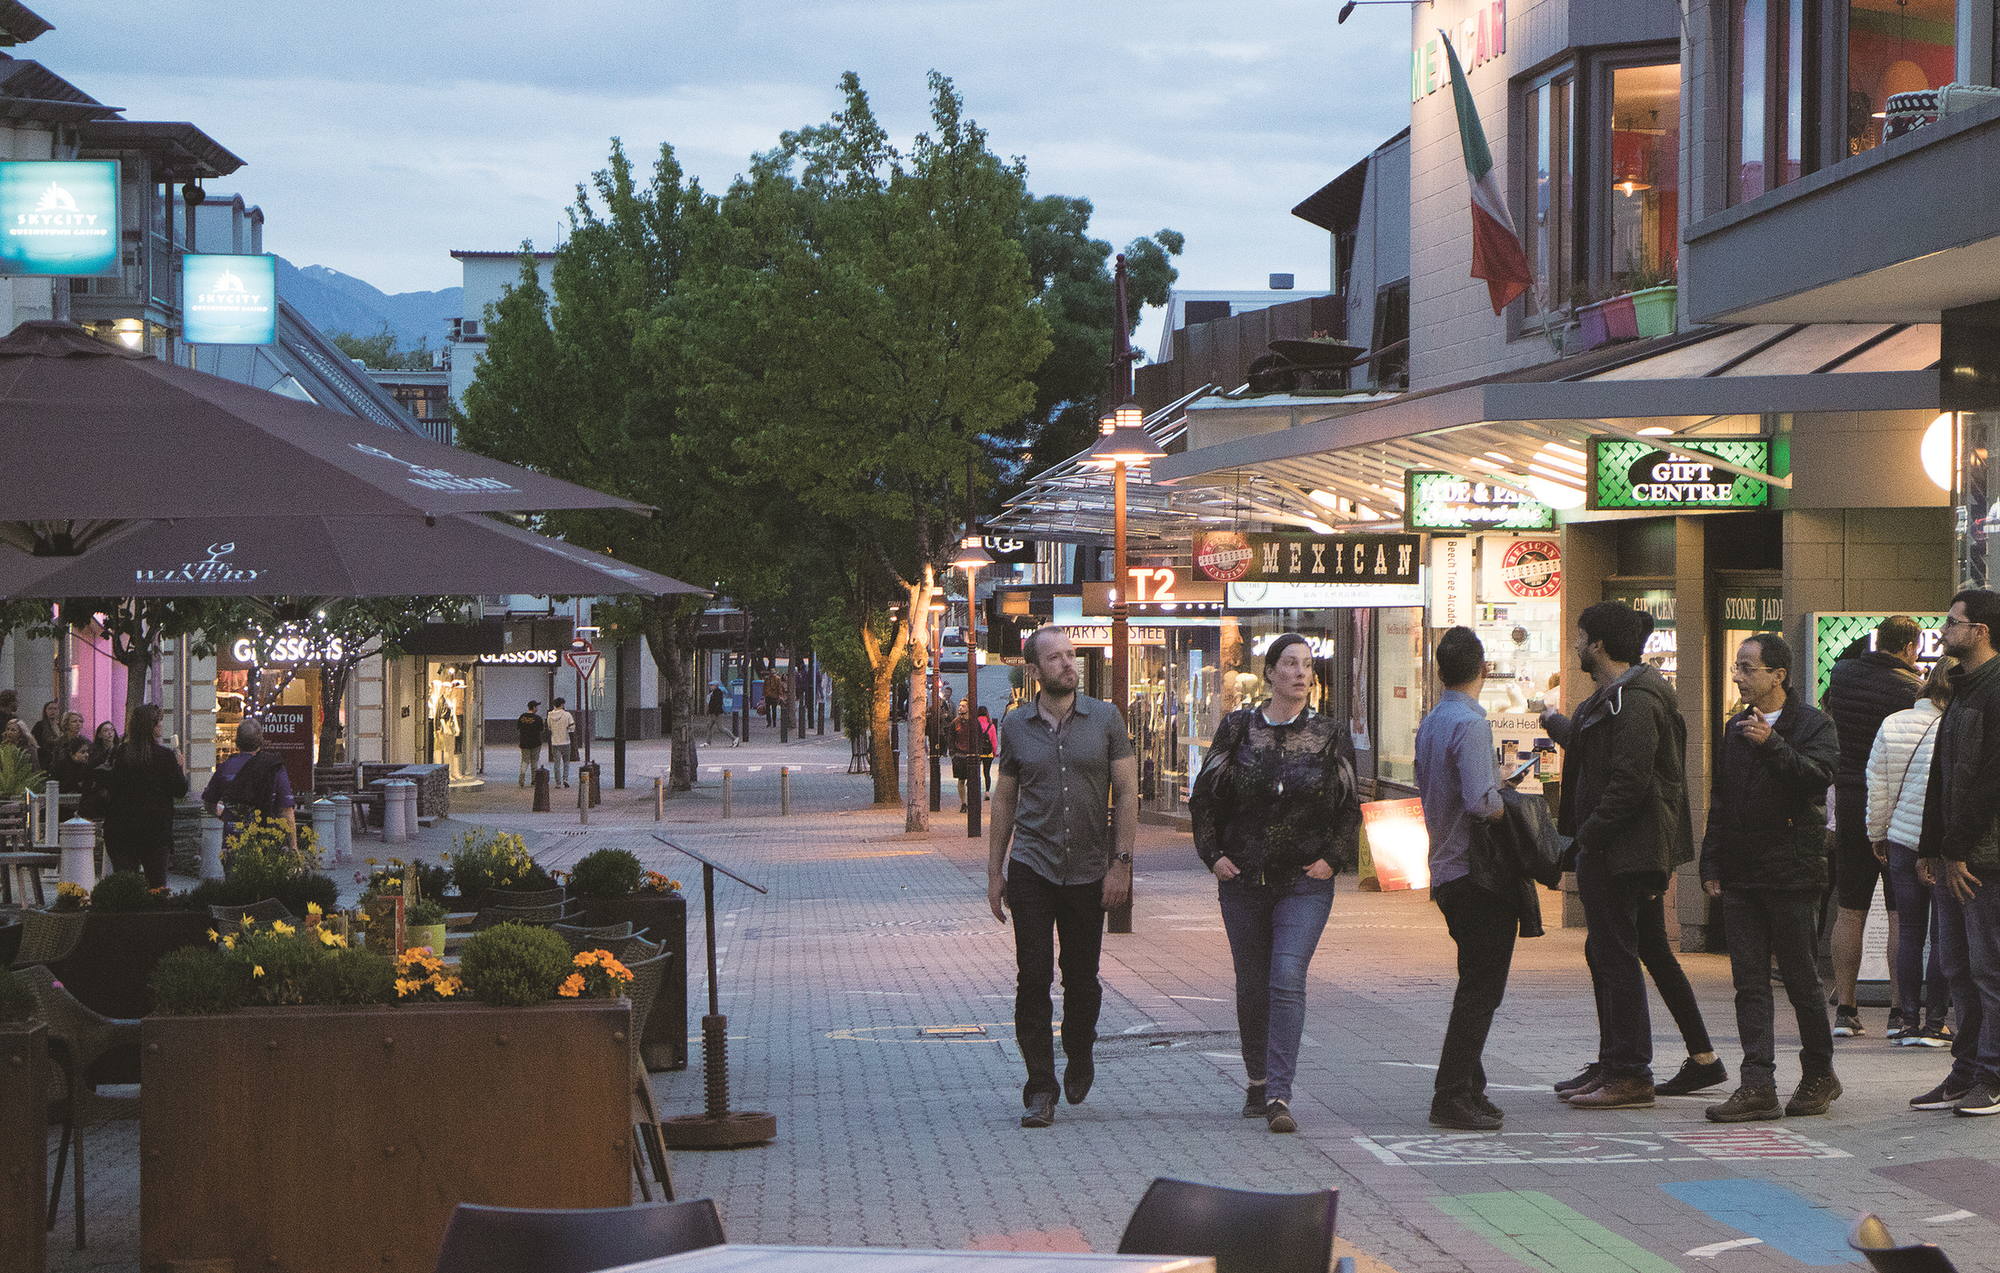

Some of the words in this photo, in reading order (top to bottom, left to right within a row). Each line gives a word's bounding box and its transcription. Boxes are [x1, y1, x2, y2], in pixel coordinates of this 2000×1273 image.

[17, 213, 98, 225] SKYCITY
[198, 293, 261, 304] SKYCITY
[1652, 463, 1713, 482] GIFT
[1632, 483, 1732, 501] CENTRE
[1262, 542, 1413, 576] MEXICAN
[1447, 541, 1458, 568] Beech
[1507, 542, 1558, 563] MEXICAN
[136, 569, 268, 580] WINERY
[182, 562, 233, 571] THE
[1128, 568, 1175, 600] T2
[1447, 572, 1458, 591] Tree
[1447, 594, 1457, 624] Arcade
[1725, 597, 1757, 620] STONE
[480, 649, 558, 663] GLASSONS
[262, 723, 296, 733] HOUSE
[1488, 717, 1515, 729] nuka
